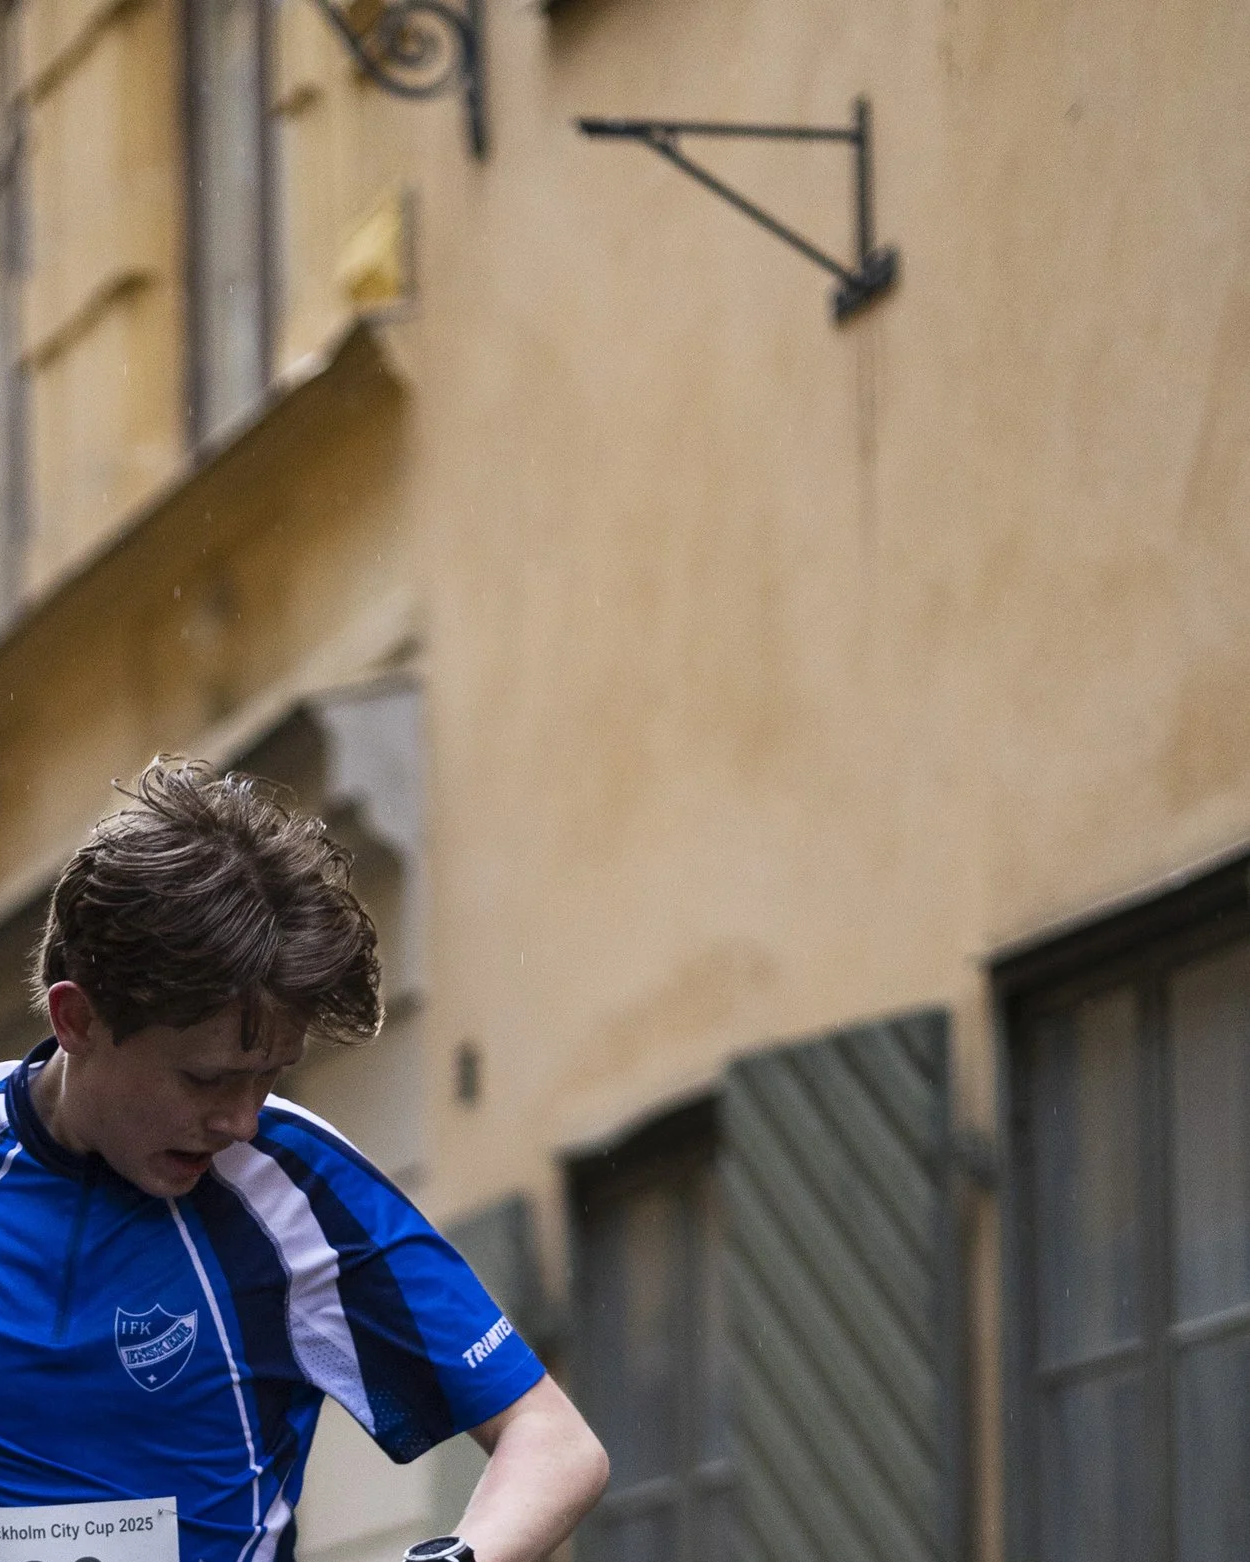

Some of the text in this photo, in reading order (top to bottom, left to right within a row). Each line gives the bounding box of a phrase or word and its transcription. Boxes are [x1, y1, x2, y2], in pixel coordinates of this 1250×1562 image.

[121, 1321, 152, 1335] IFK
[125, 1322, 193, 1363] ENSKEDE
[51, 1523, 80, 1541] City
[85, 1520, 115, 1537] Cup
[119, 1516, 154, 1533] 2025
